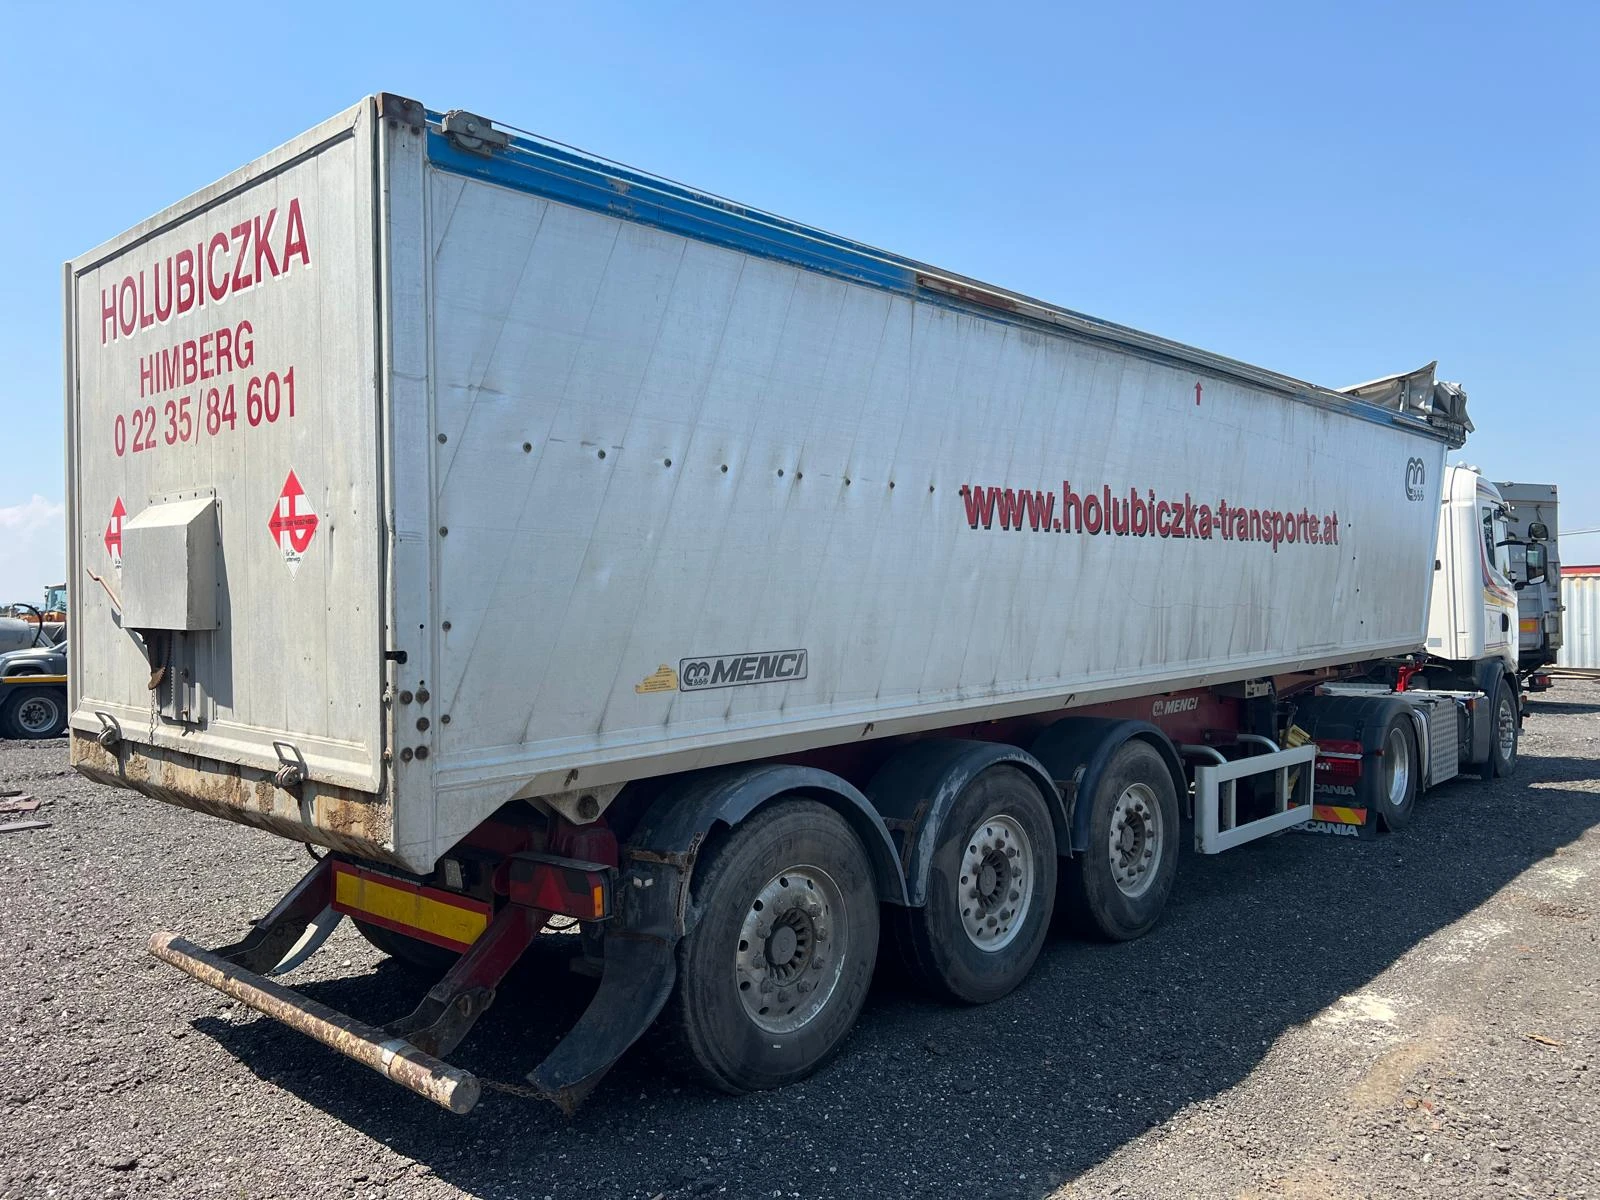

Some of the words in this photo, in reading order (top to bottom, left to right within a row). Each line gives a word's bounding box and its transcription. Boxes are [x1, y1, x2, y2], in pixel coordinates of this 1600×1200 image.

[101, 197, 311, 345] HOLUBICZKA
[139, 319, 255, 399] HIMBERG
[114, 413, 127, 457] 0
[132, 405, 157, 453] 22
[246, 366, 296, 428] 601
[961, 480, 1339, 553] www.holubiczka-transporte.at
[710, 652, 805, 685] MENCI
[1164, 696, 1199, 715] MENCI
[1314, 783, 1356, 796] CANIA
